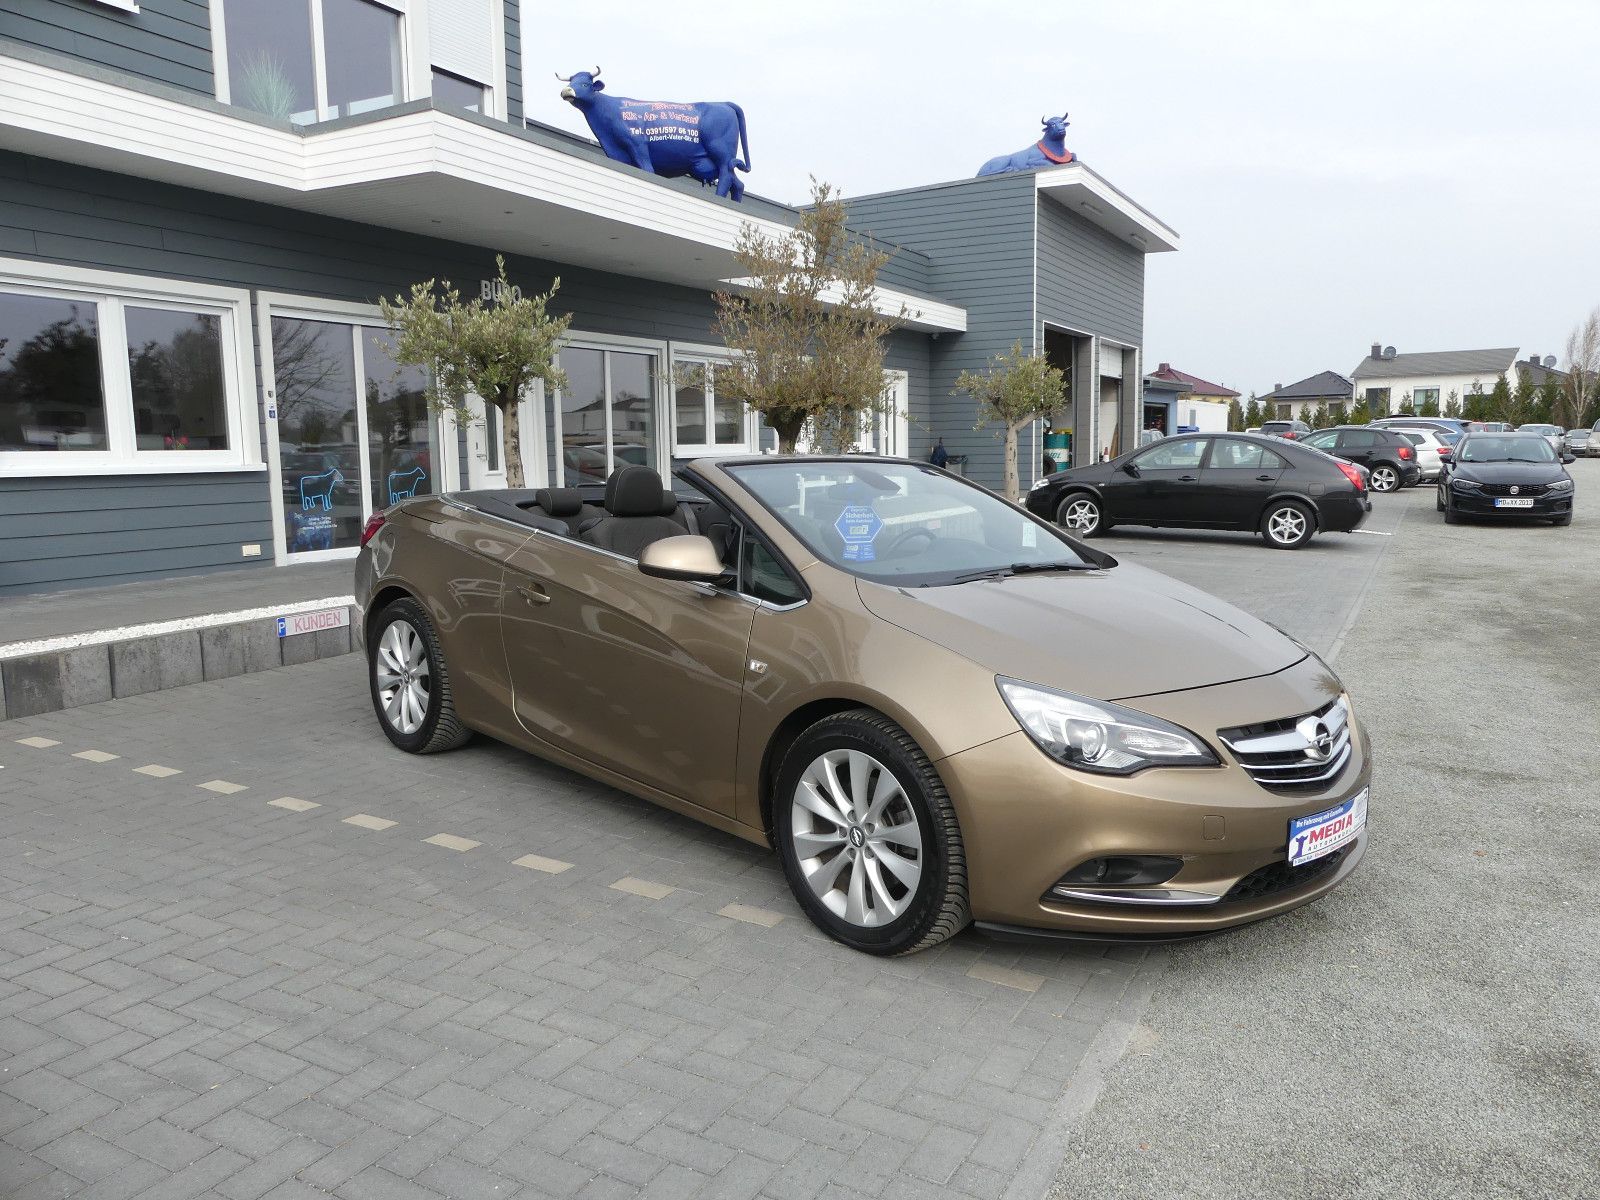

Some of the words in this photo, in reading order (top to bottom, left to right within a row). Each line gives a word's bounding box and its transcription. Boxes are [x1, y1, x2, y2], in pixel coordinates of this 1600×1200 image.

[629, 127, 644, 135] Tel.
[645, 126, 676, 135] 0391/597
[688, 129, 699, 137] 100
[278, 621, 286, 634] P
[294, 611, 342, 633] KUNDEN
[1309, 813, 1353, 844] MEDIA
